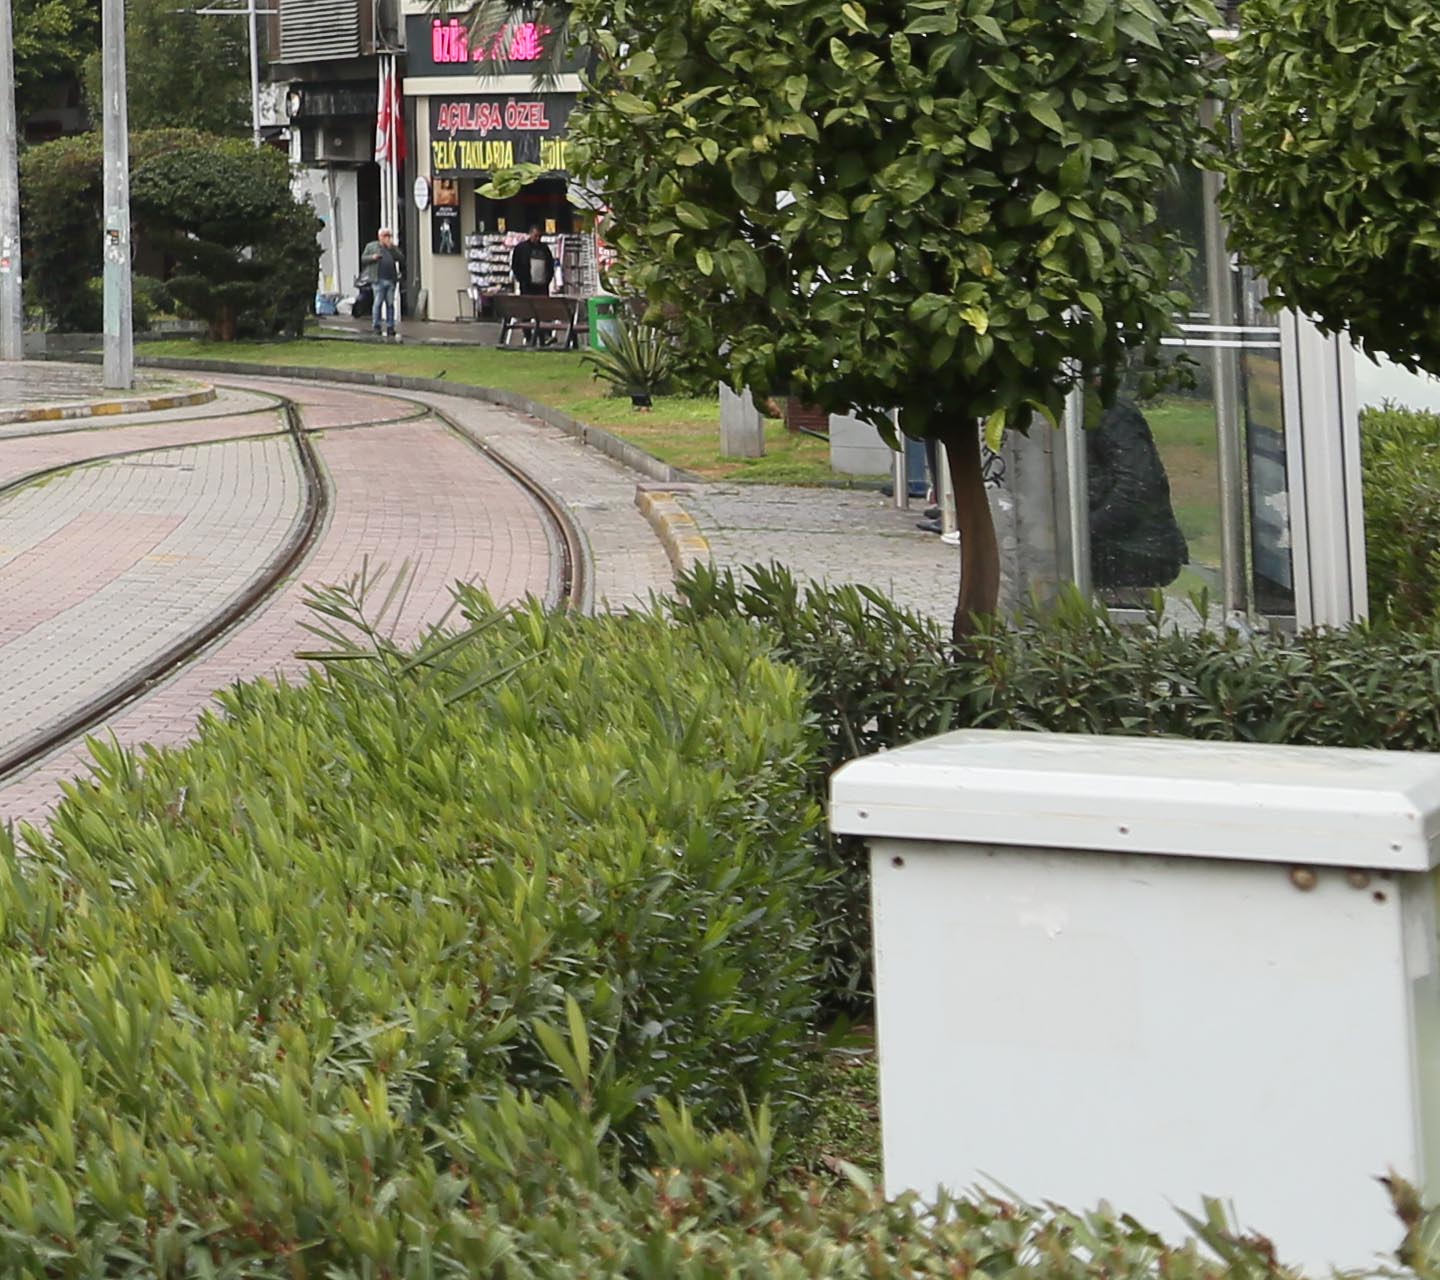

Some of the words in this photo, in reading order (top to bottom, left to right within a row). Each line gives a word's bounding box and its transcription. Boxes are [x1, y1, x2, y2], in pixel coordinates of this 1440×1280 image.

[438, 101, 502, 137] AÇILIŞA
[505, 97, 550, 130] ÖZEL
[459, 139, 514, 171] TAKILARDA
